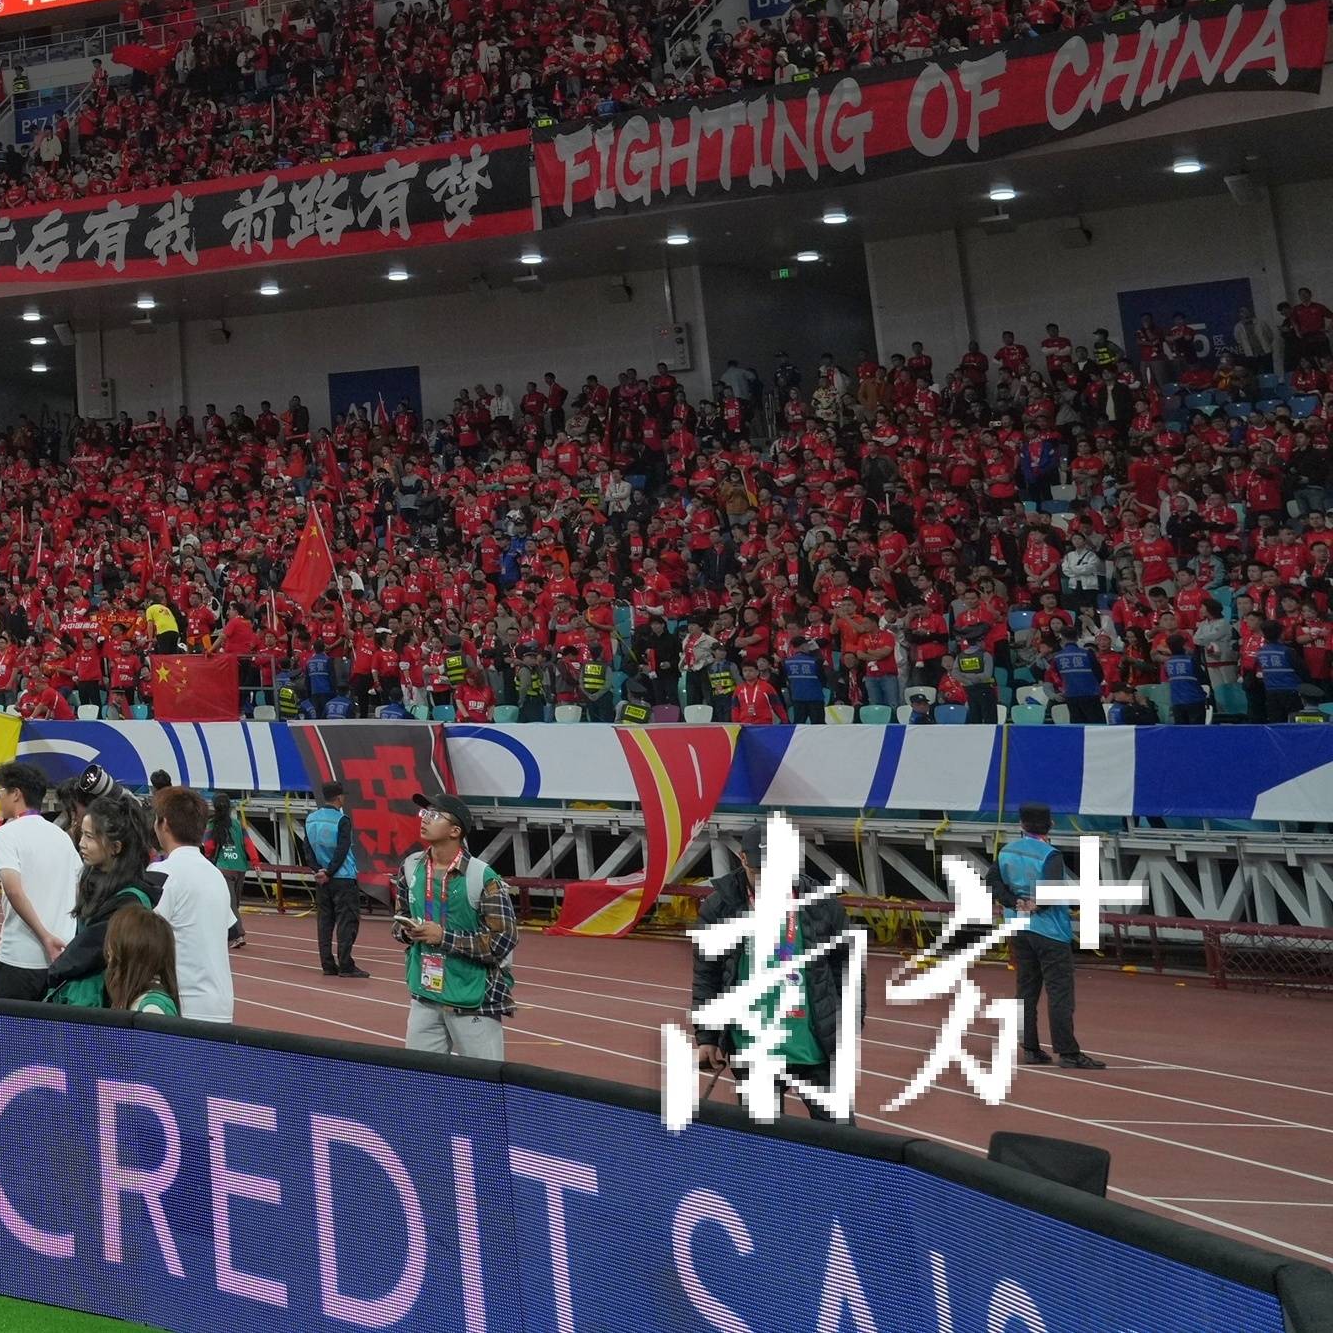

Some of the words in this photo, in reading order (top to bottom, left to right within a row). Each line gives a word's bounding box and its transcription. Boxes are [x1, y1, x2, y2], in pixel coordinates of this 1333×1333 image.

[555, 77, 874, 217] FIGHTING
[906, 50, 1009, 157] OF
[222, 144, 494, 255] 前路有梦
[789, 664, 813, 674] 安保
[1060, 657, 1084, 669] 安保
